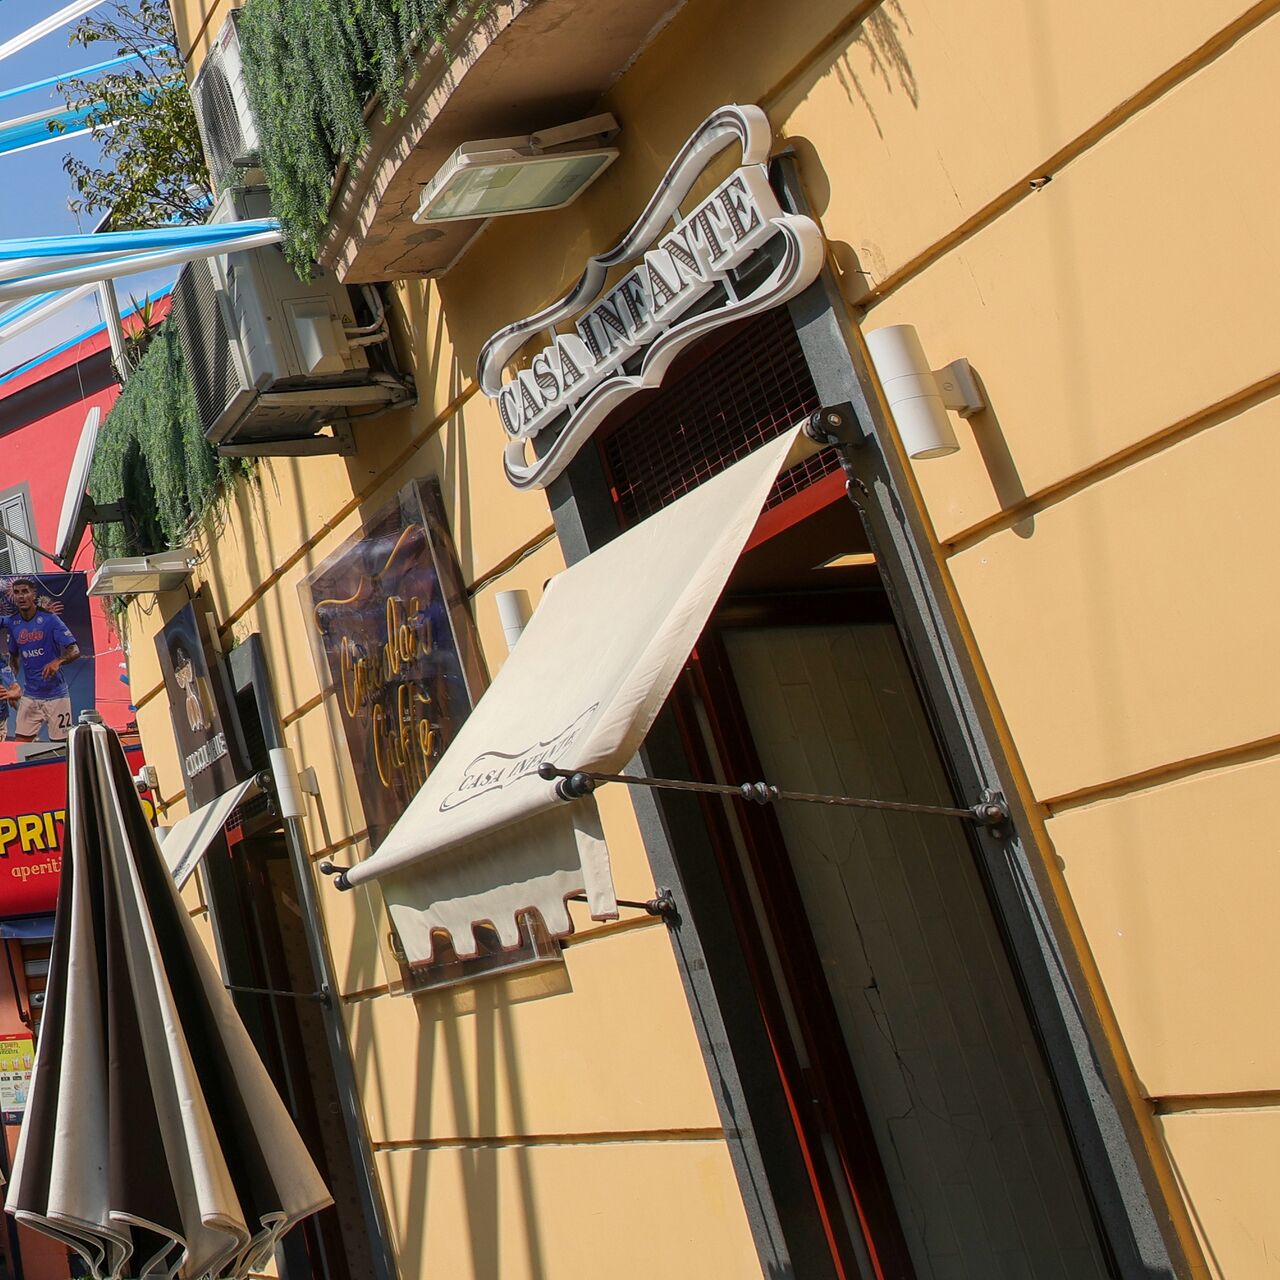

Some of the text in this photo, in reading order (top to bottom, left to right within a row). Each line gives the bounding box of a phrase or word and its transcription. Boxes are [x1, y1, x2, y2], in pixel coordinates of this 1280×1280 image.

[498, 177, 764, 435] CASA INFANTE
[28, 647, 45, 658] MSC
[58, 712, 71, 729] 22
[458, 771, 502, 792] CASA
